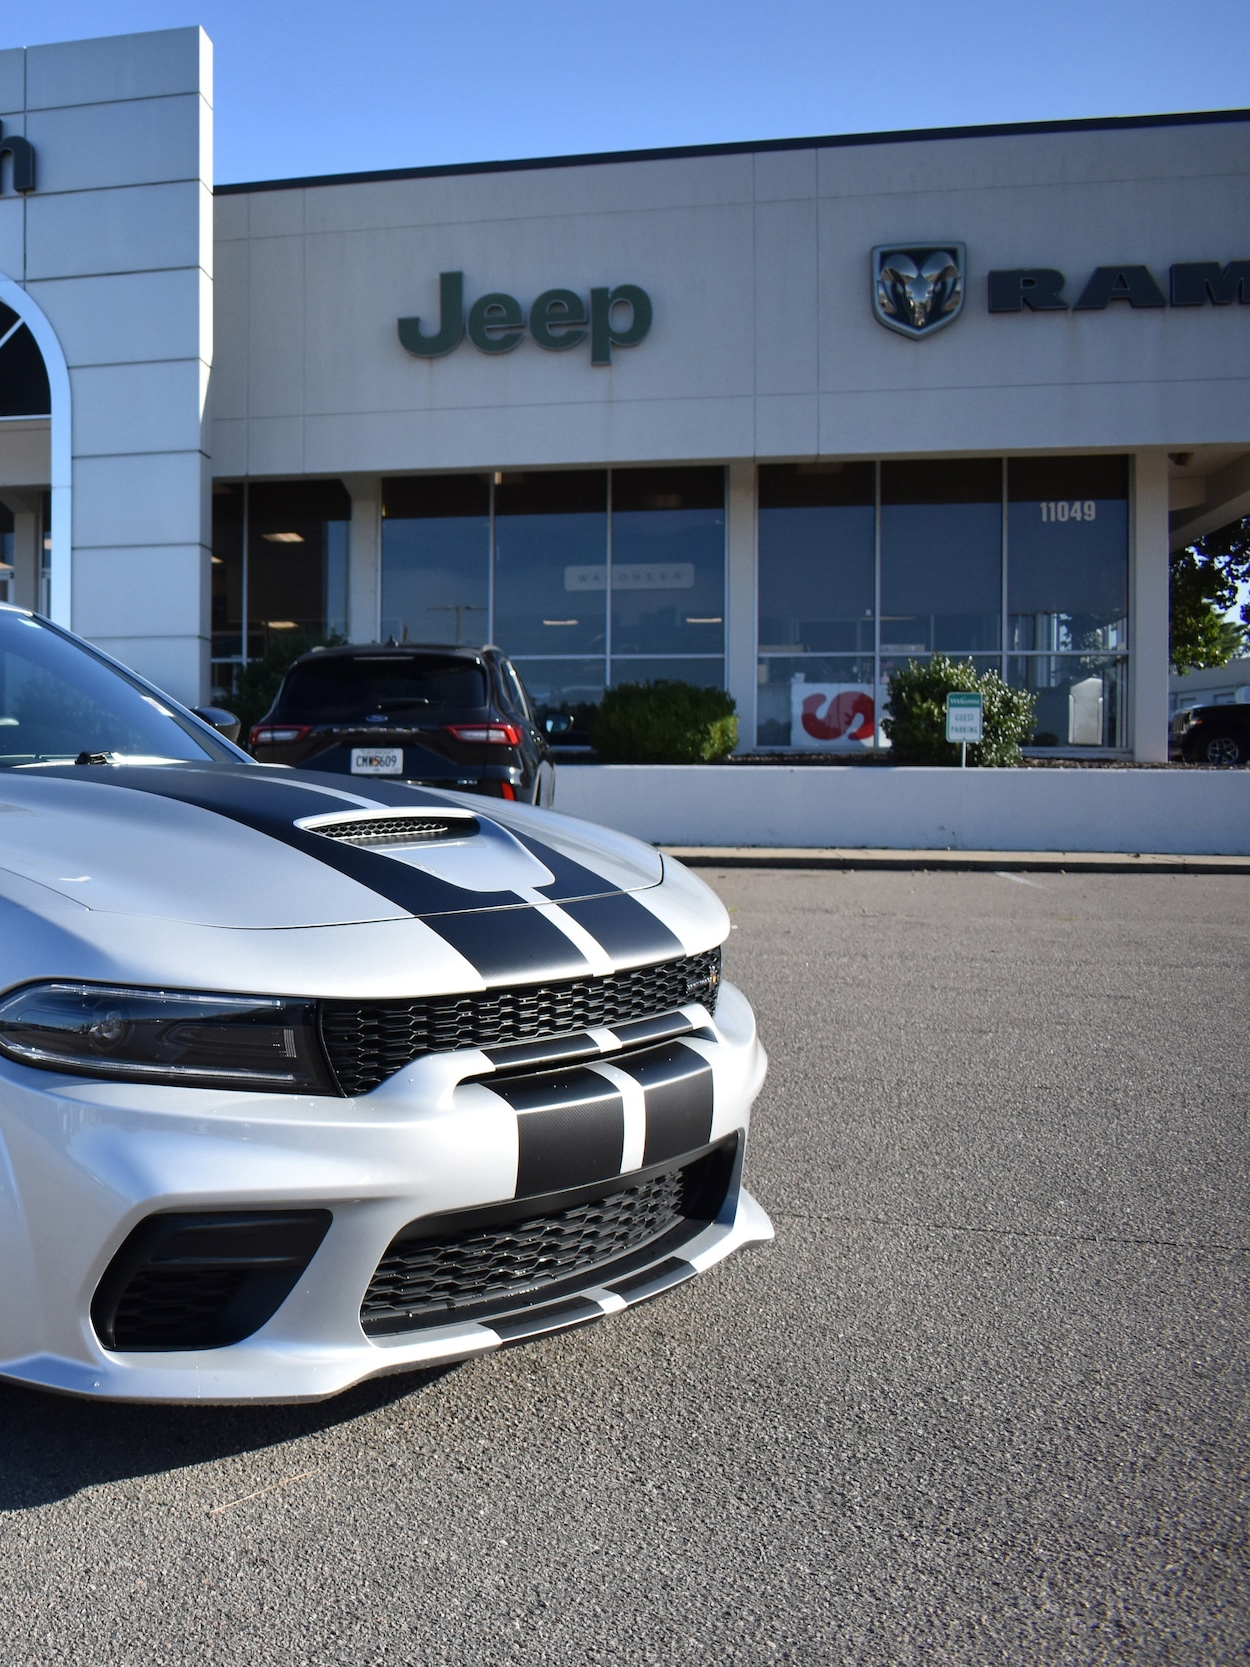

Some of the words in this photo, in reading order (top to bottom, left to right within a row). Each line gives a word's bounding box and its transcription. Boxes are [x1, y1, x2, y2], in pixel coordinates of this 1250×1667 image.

[988, 260, 1250, 313] RAM
[398, 271, 652, 365] Jeep
[1040, 500, 1096, 522] 11049
[577, 571, 682, 583] WAONEER
